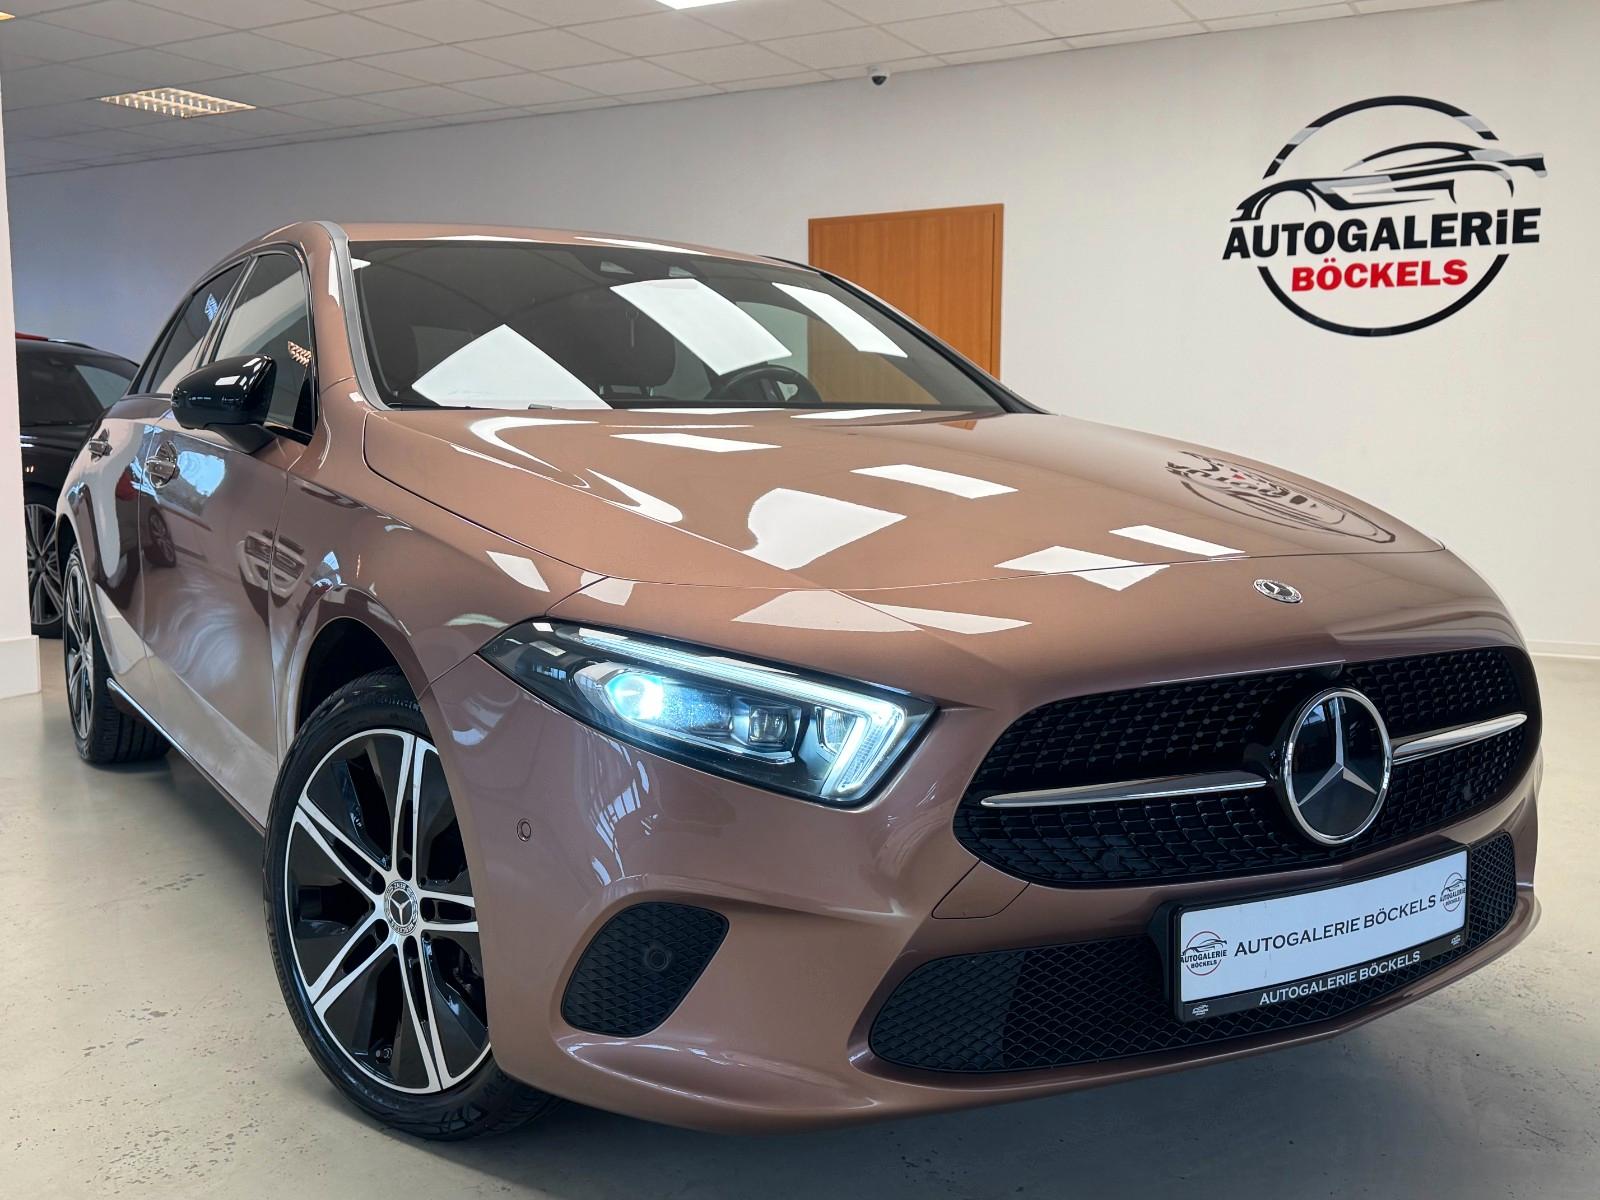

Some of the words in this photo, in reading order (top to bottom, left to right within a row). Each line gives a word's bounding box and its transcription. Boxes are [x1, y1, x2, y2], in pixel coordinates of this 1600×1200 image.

[1291, 257, 1469, 292] BÖCKELS
[1234, 917, 1360, 957] AUTOGALERIE
[1363, 894, 1436, 928] BÖCKELS
[1180, 949, 1227, 963] AUTOGALERIE
[1259, 970, 1357, 1006] AUTOGALERIE
[1358, 951, 1420, 980] BÖCKELS
